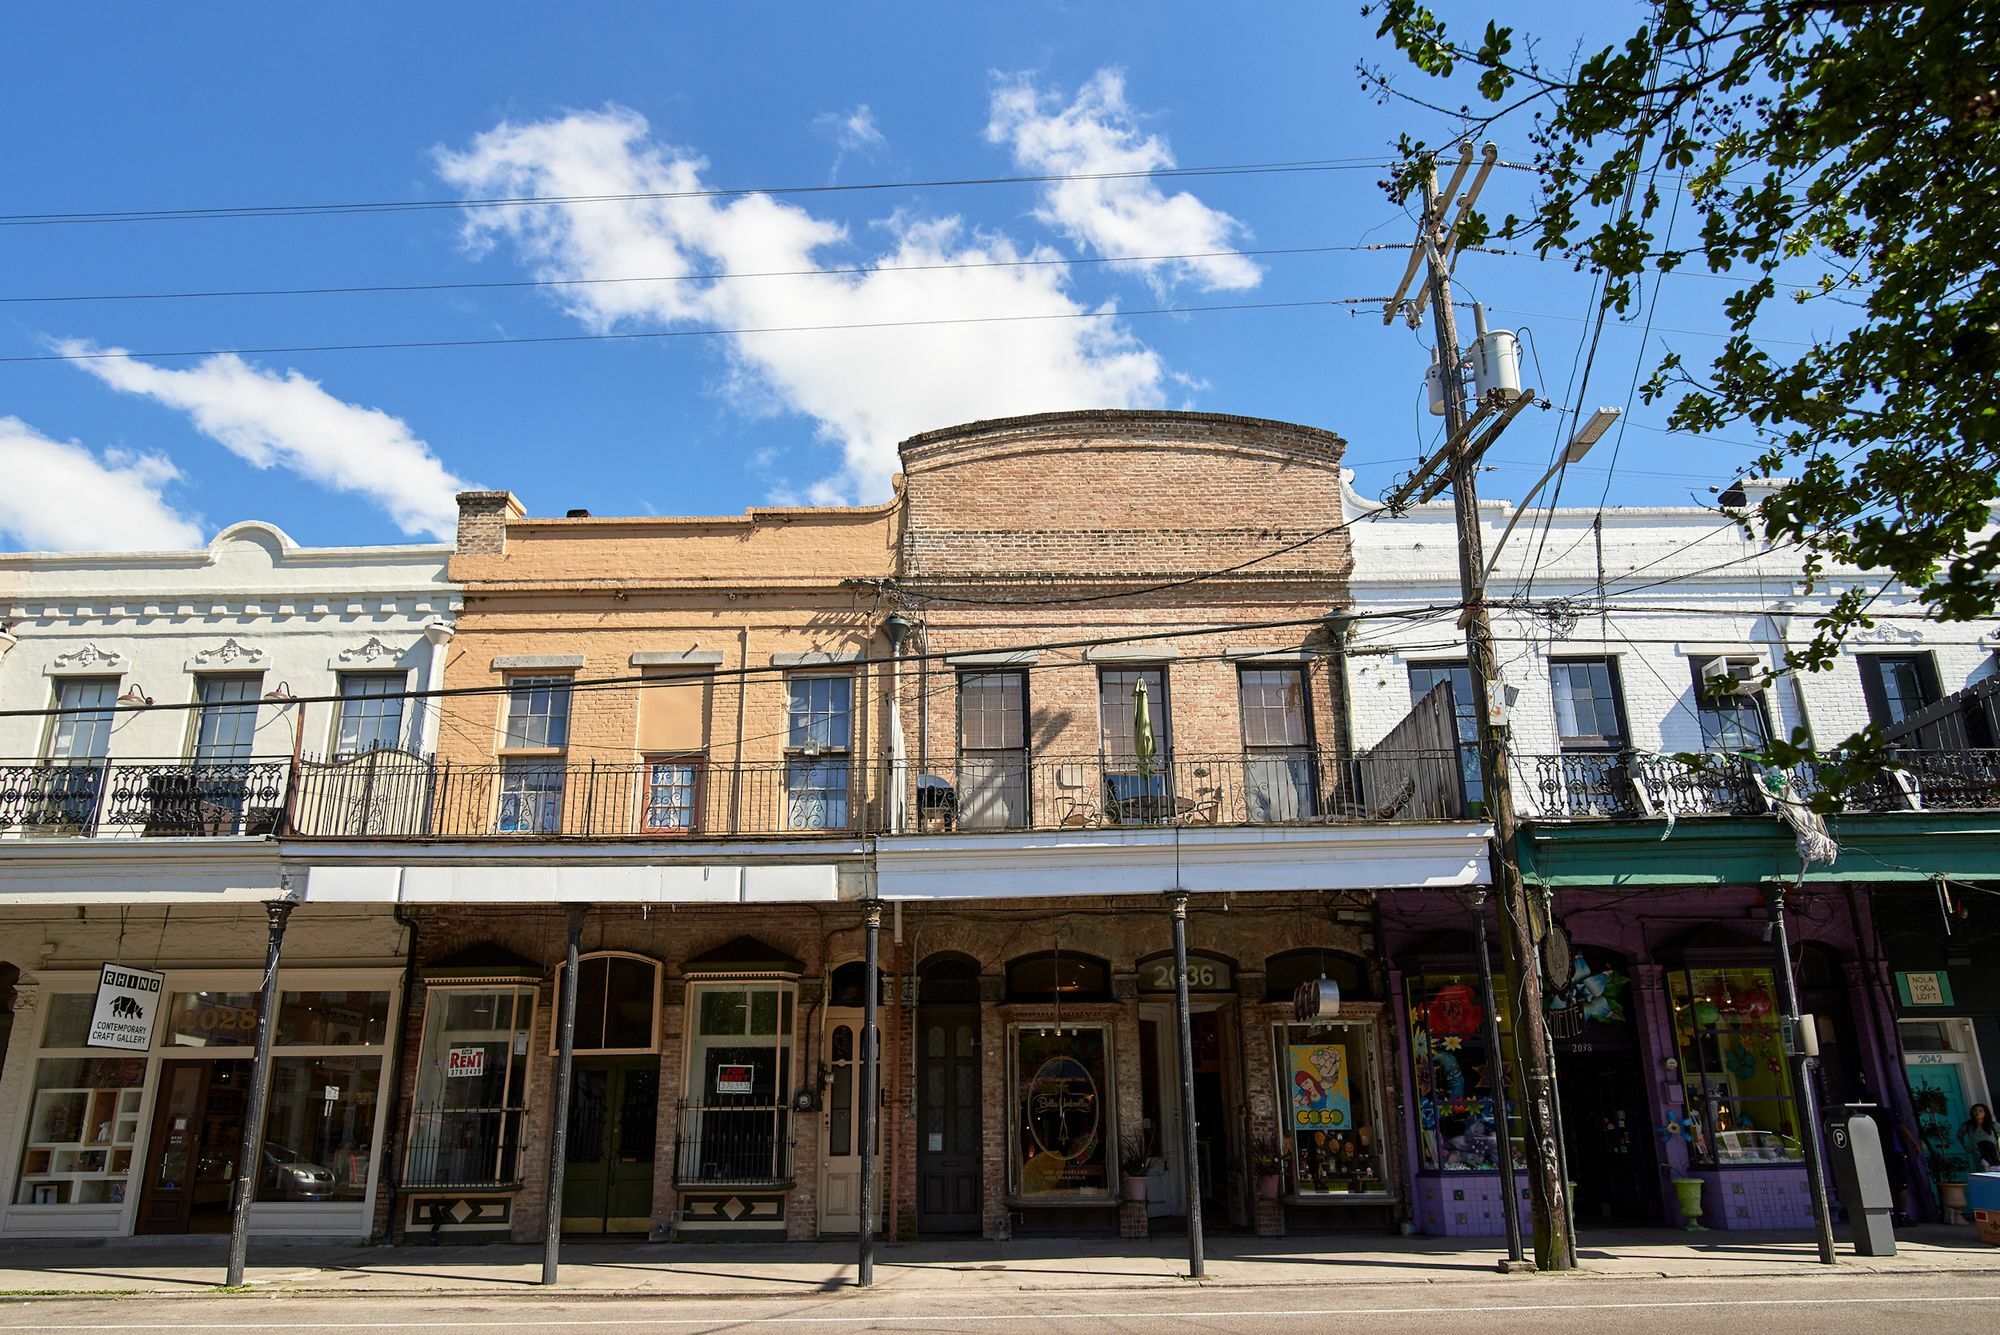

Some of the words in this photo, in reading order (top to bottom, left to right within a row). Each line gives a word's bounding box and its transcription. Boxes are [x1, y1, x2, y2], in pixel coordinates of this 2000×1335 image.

[105, 972, 160, 992] RHINO
[1917, 993, 1937, 1001] LOFT
[180, 1008, 258, 1031] 2028
[97, 1021, 147, 1034] CONTEMPORARY
[92, 1031, 115, 1041] CRAFT
[117, 1034, 147, 1044] GALLERY
[1572, 1043, 1593, 1053] 2038
[450, 1051, 483, 1069] RENT
[1918, 1055, 1943, 1063] 2042
[722, 1074, 750, 1082] RENT
